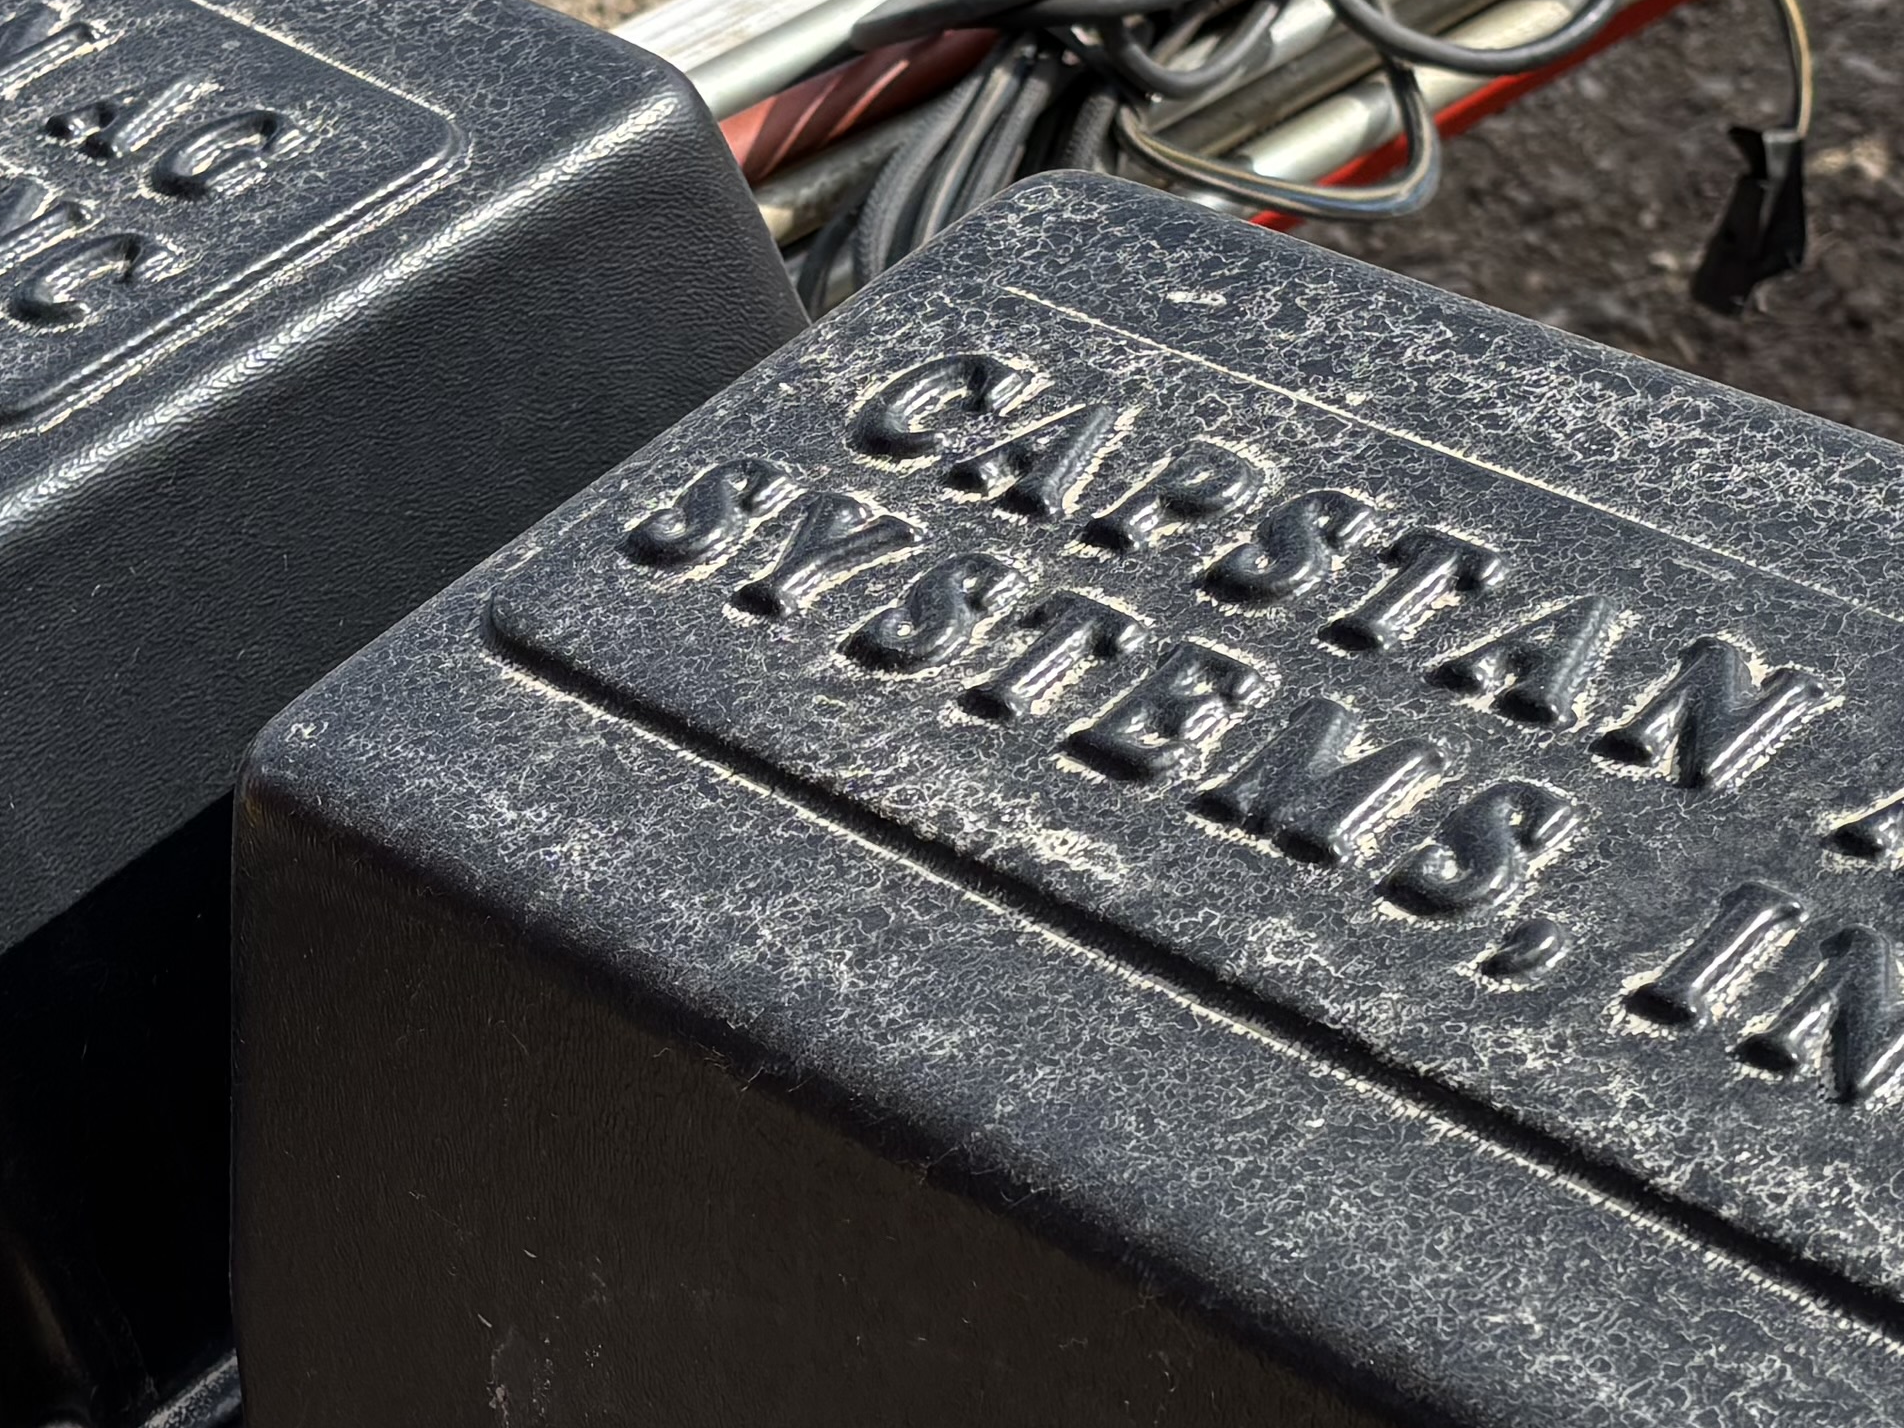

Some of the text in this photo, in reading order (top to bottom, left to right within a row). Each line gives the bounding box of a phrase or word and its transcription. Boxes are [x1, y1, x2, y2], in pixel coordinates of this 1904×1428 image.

[46, 74, 304, 200] AG
[624, 456, 1579, 982] SYSTEMS,
[845, 349, 1831, 789] CAPSTAN
